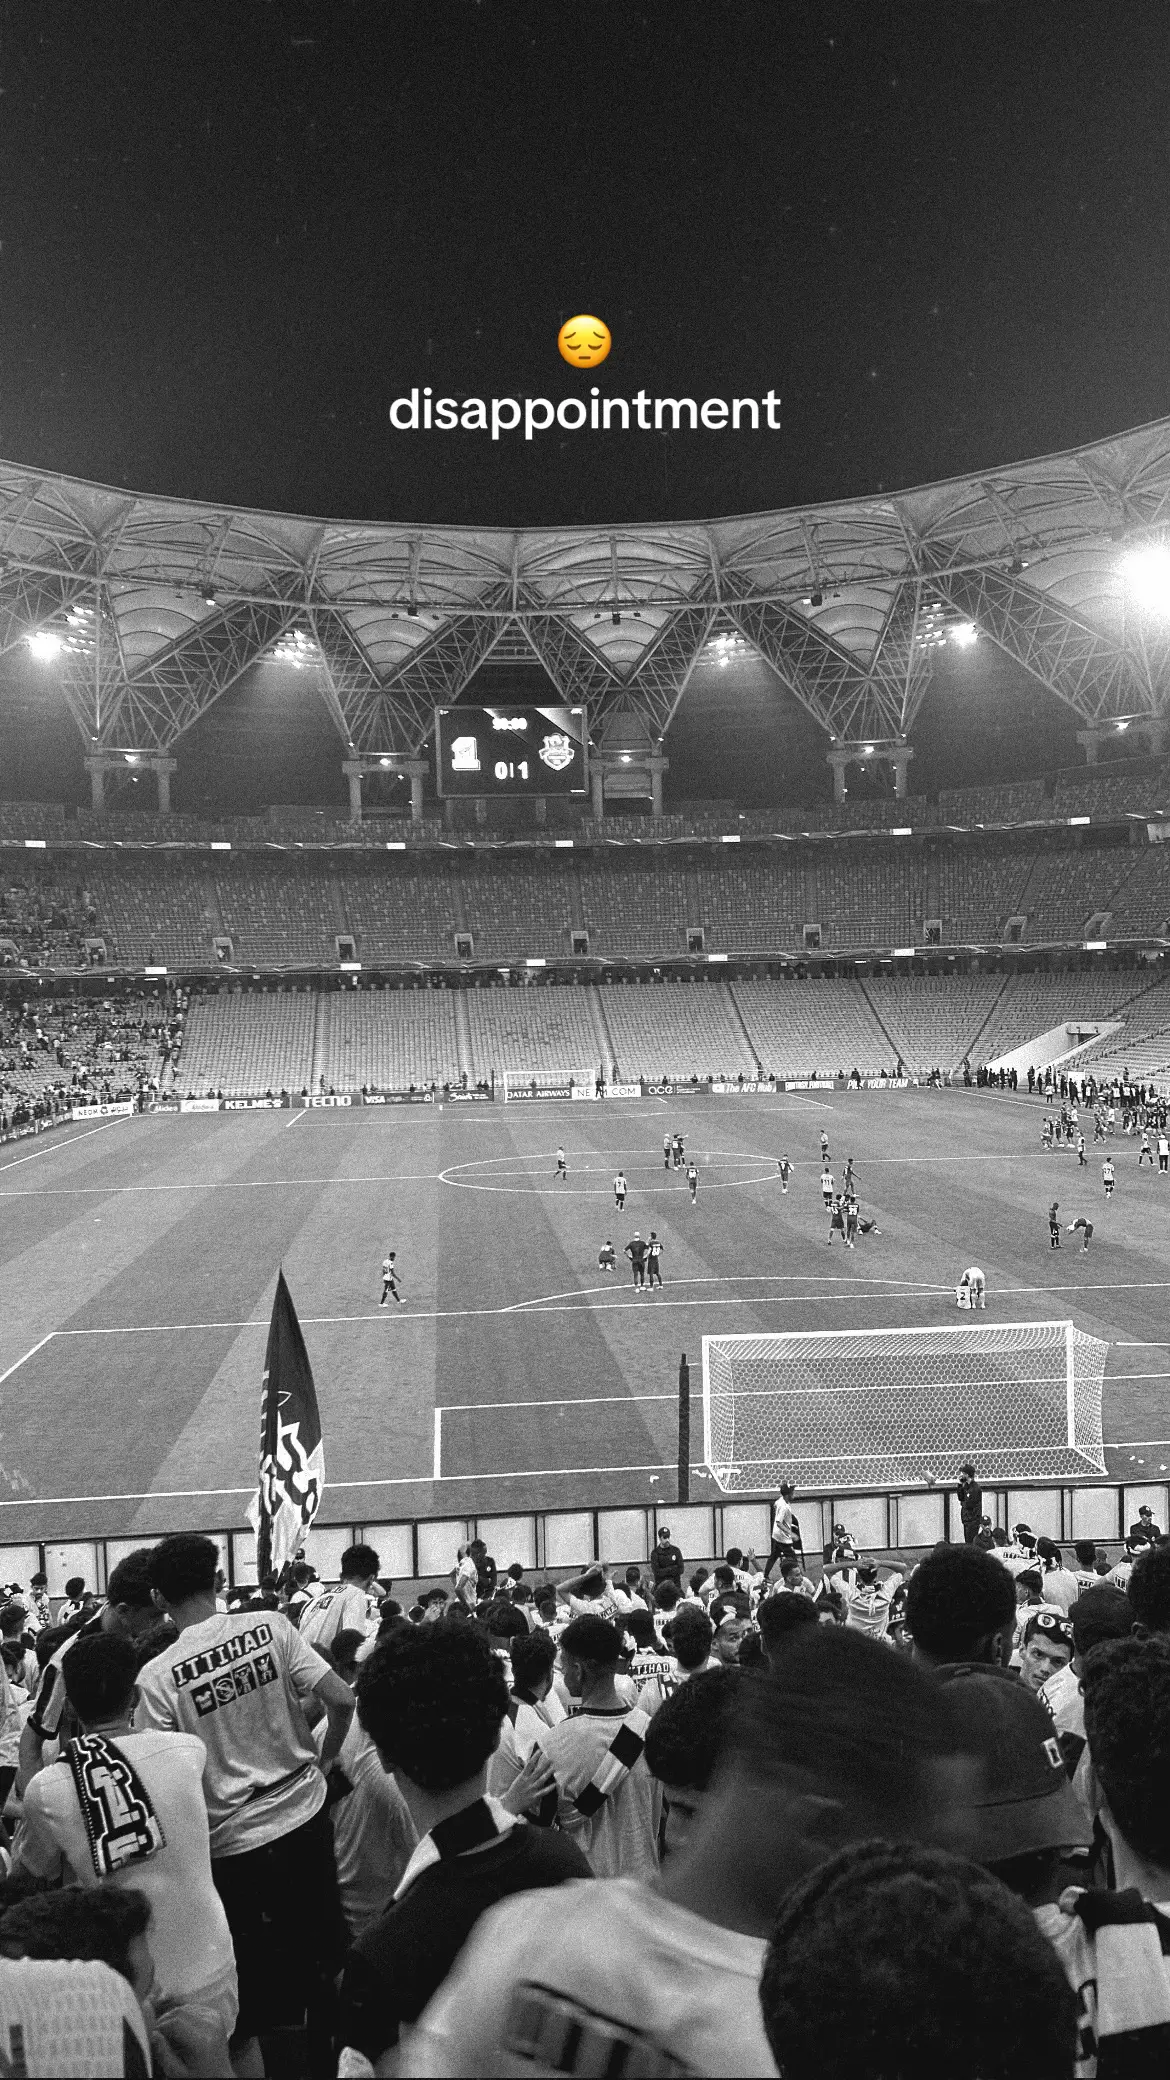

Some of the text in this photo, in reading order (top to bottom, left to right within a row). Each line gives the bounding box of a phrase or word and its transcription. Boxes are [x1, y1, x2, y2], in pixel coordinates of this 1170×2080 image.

[741, 1082, 757, 1092] AFC
[888, 1078, 909, 1088] TEAM
[507, 1089, 571, 1099] QATAR AIRWAYS
[225, 1099, 274, 1110] KELME
[301, 1095, 352, 1108] TECNO
[364, 1095, 386, 1104] VISA
[79, 1108, 98, 1116] NEOM
[960, 1291, 966, 1301] 2
[172, 1624, 274, 1688] ITTIHAD
